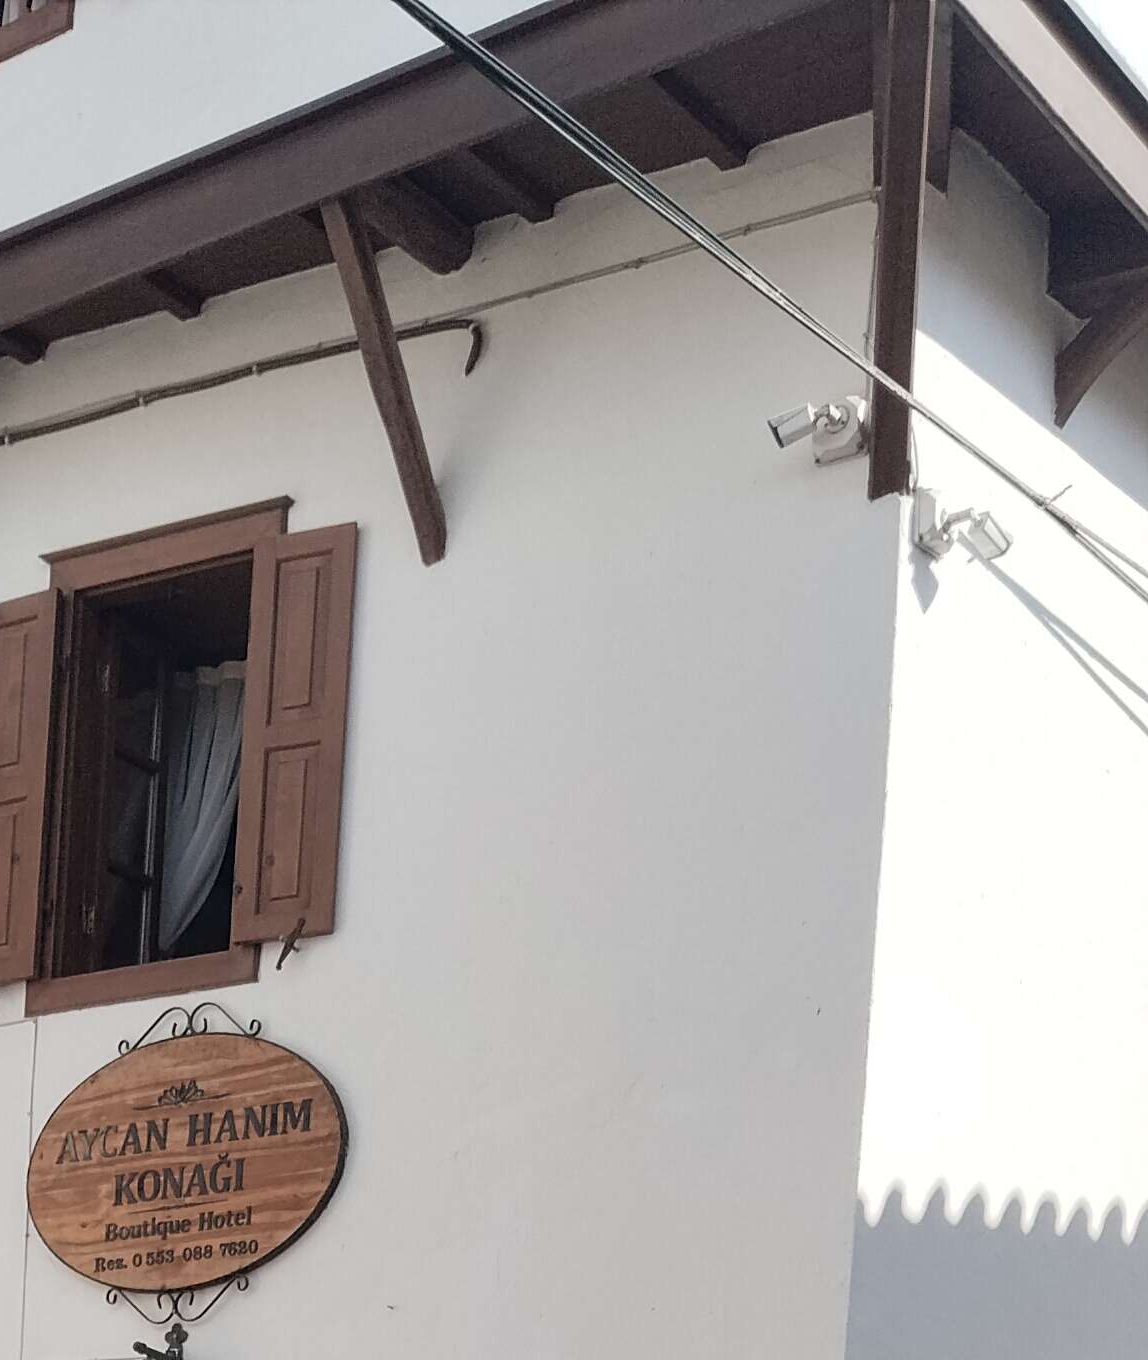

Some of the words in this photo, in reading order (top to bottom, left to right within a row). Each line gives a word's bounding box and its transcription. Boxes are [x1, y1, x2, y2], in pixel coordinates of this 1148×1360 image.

[55, 1118, 170, 1164] AYCAN
[186, 1098, 314, 1148] HANIM
[112, 1152, 246, 1207] KONAĞI
[104, 1216, 192, 1242] Boutique
[198, 1206, 253, 1232] Hotel
[93, 1257, 128, 1273] Rez.
[182, 1244, 213, 1261] 088
[219, 1240, 259, 1257] 7620
